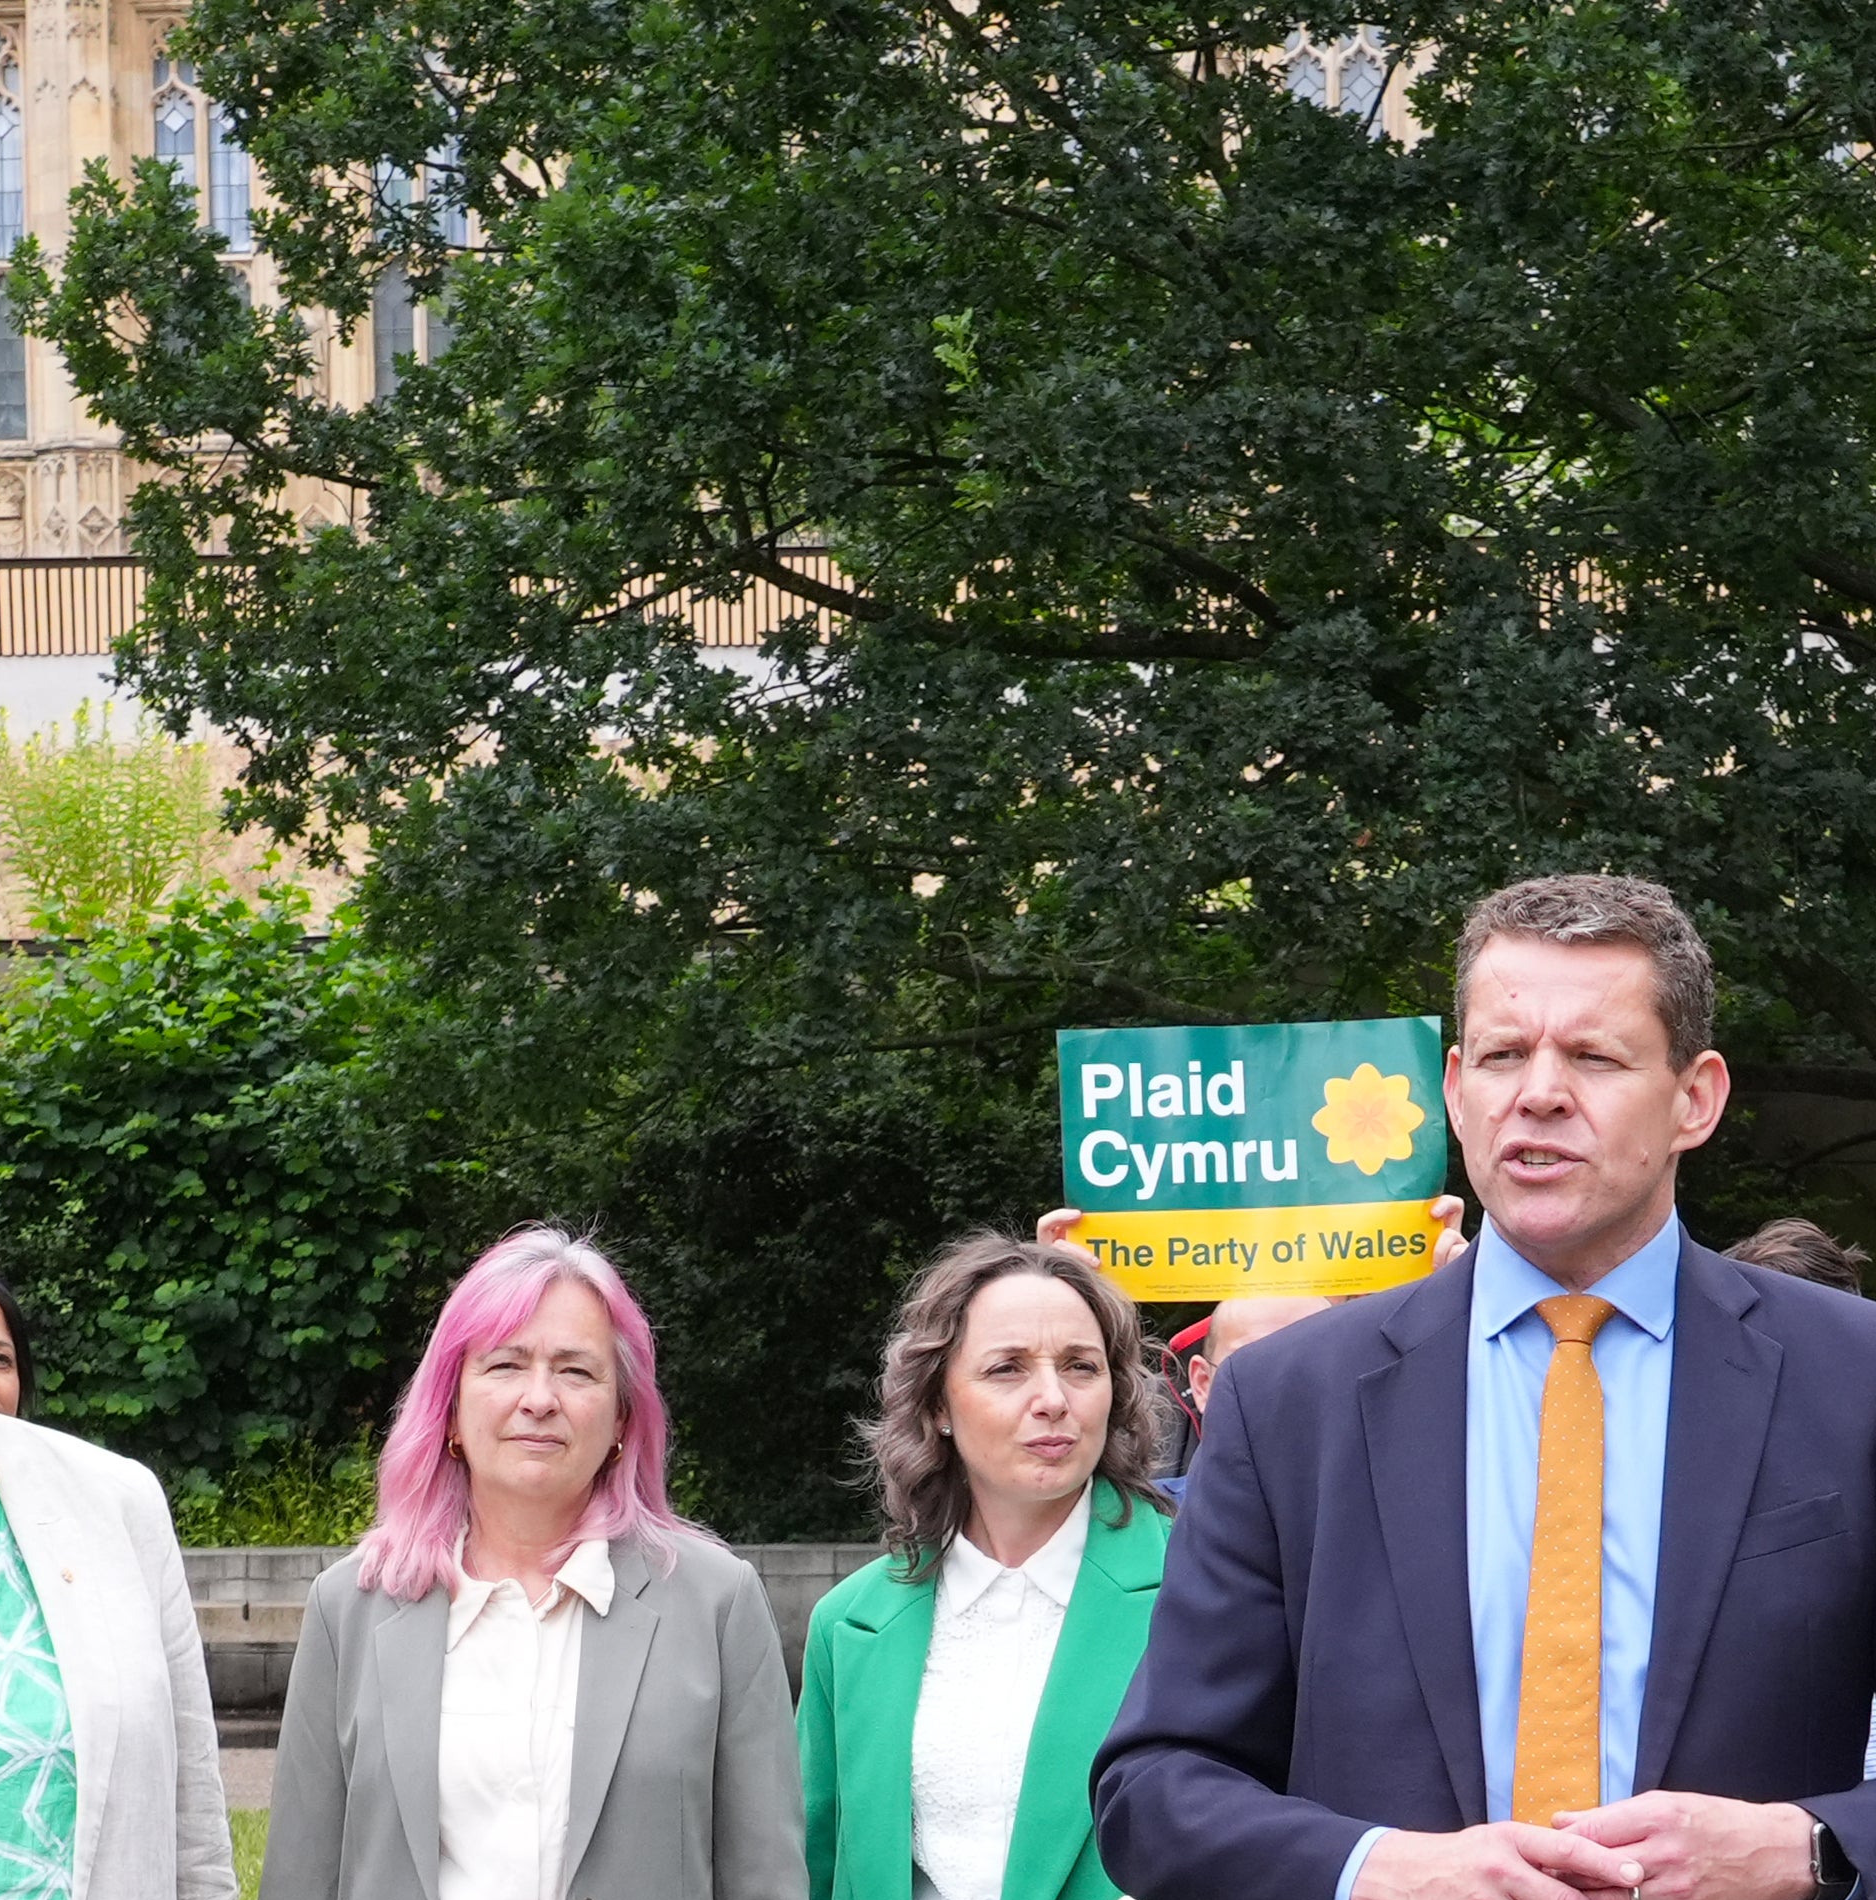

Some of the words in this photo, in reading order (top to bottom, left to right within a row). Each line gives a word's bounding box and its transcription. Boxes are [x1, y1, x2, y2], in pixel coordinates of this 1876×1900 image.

[1081, 1060, 1246, 1118] Plaid
[1079, 1130, 1298, 1200] Cymru
[1086, 1238, 1154, 1267] The
[1168, 1237, 1258, 1272] Party
[1273, 1233, 1306, 1263] of
[1319, 1229, 1427, 1260] Wales
